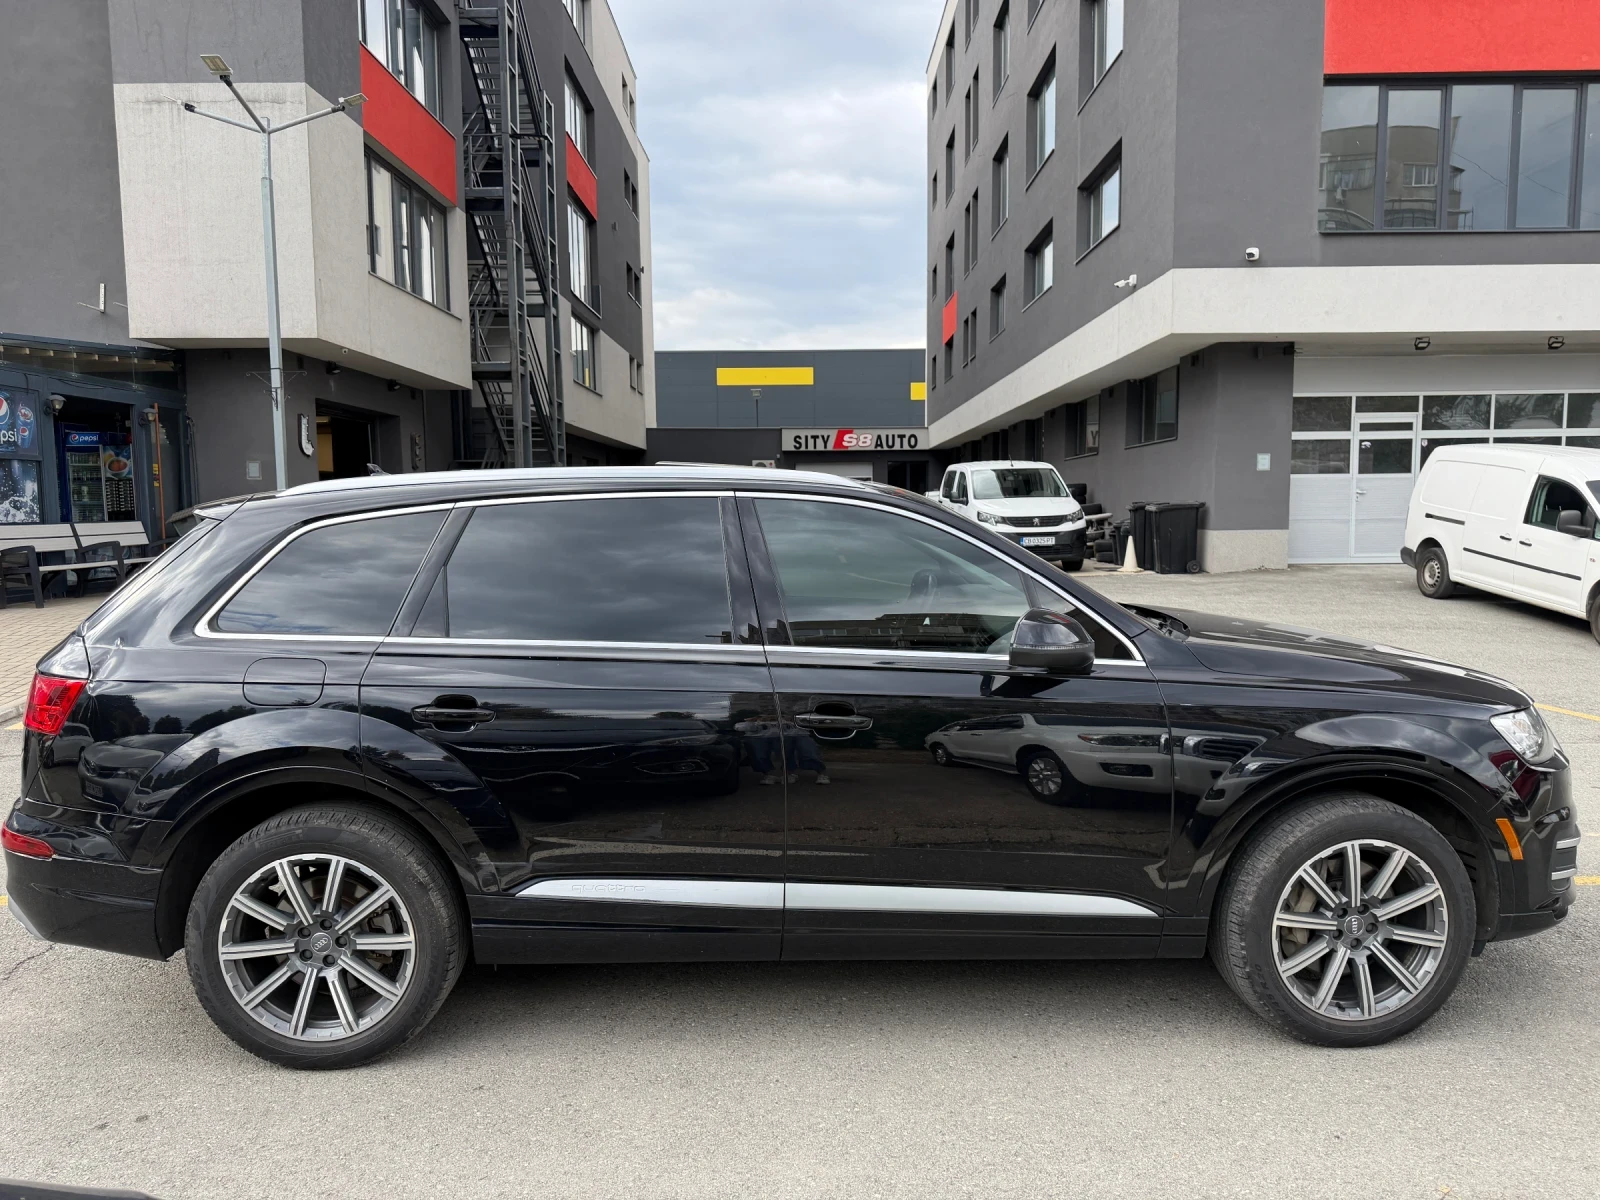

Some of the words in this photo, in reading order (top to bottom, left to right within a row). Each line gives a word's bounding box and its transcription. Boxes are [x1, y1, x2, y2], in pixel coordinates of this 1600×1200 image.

[0, 429, 18, 444] psi
[80, 434, 99, 442] pepsi
[793, 435, 830, 450] SITY
[842, 433, 873, 447] S8
[874, 434, 918, 449] AUTO
[572, 884, 646, 893] quattro
